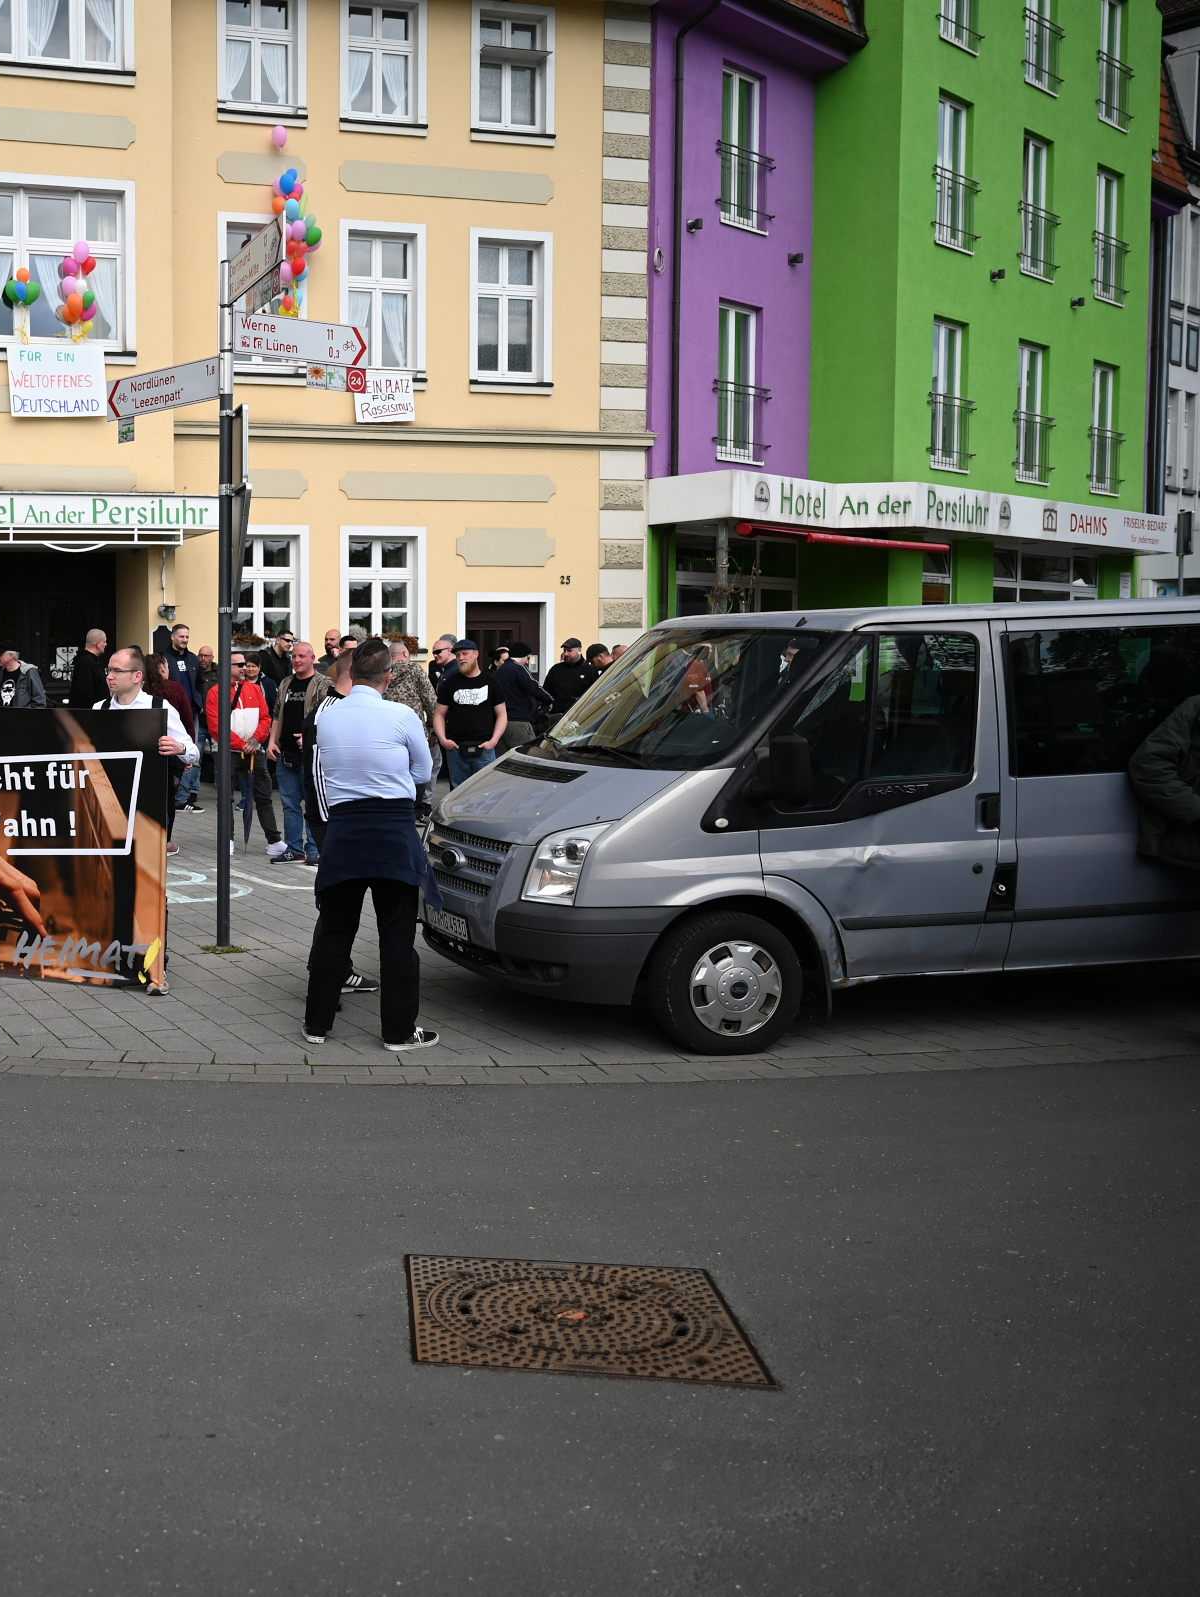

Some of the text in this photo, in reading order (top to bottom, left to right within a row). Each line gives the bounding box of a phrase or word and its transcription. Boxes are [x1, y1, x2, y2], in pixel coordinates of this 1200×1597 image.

[241, 318, 334, 341] Werne 11
[19, 350, 75, 362] FÜR EIN
[266, 338, 299, 354] Lünen
[11, 369, 94, 389] WELTOFFENES
[130, 374, 176, 393] Nordlünen
[350, 376, 362, 386] 24
[365, 378, 411, 395] EIN PLATZ
[12, 394, 100, 414] DEUTSCHLAND
[23, 504, 50, 524] An
[55, 507, 85, 525] der
[92, 498, 209, 526] Persiluhr
[780, 480, 990, 527] Hotel An der Persiluhr
[1069, 512, 1108, 537] DAHMS
[559, 575, 571, 585] 25
[46, 762, 90, 790] für
[69, 810, 78, 837] !
